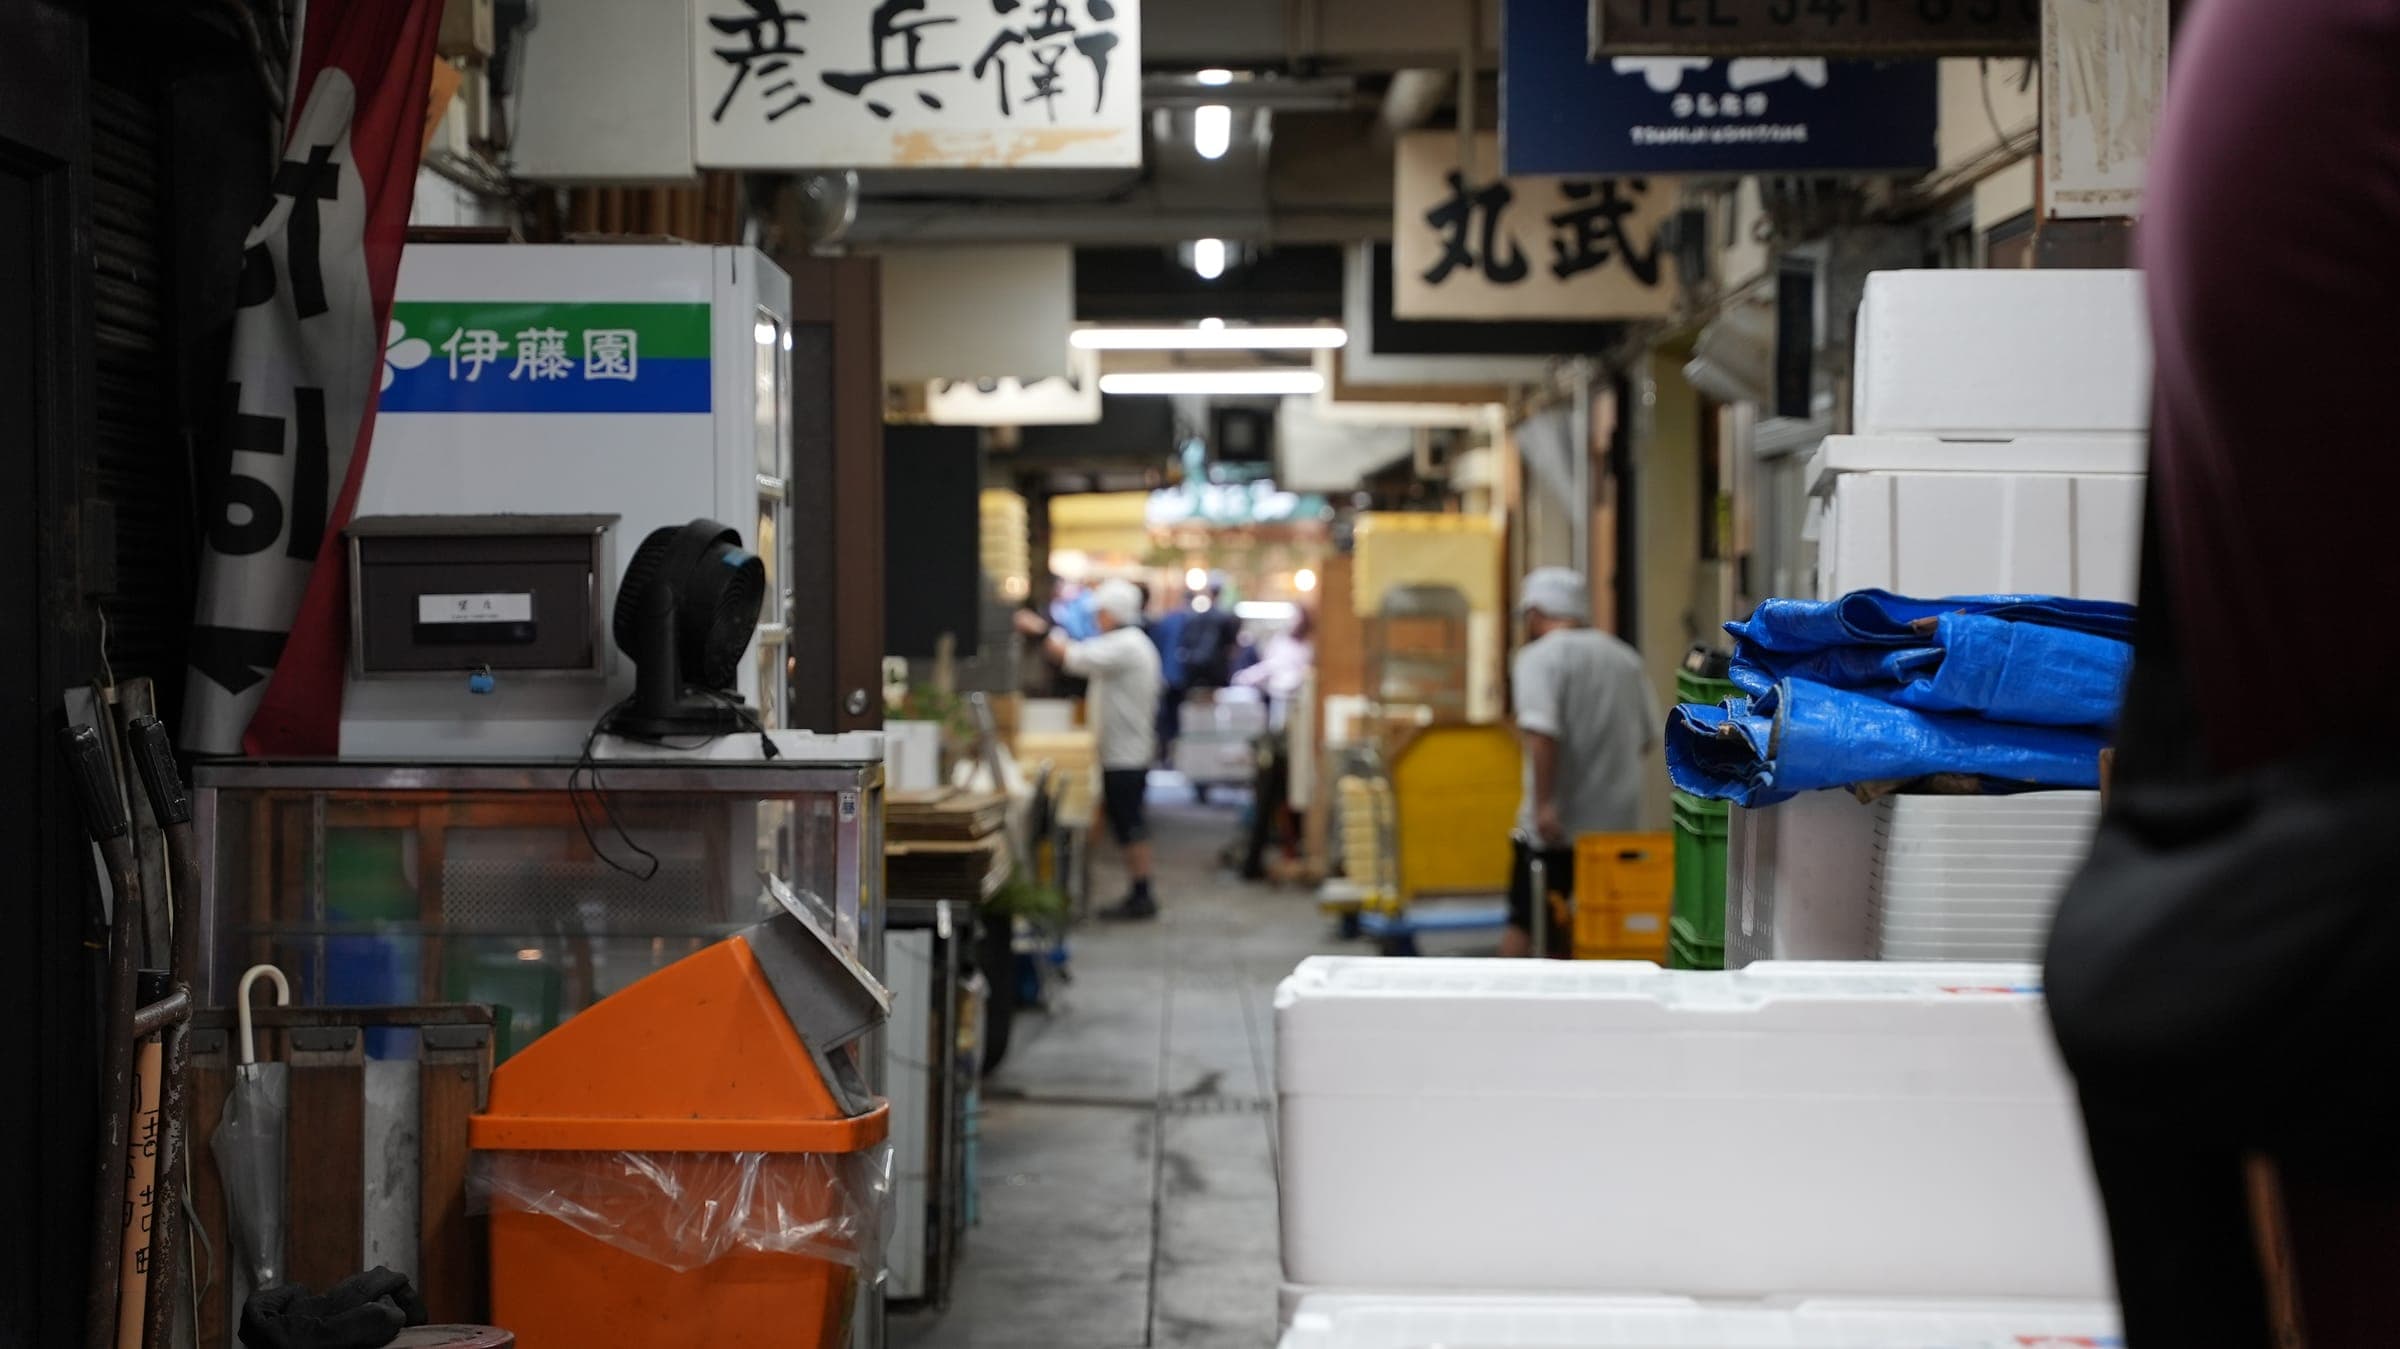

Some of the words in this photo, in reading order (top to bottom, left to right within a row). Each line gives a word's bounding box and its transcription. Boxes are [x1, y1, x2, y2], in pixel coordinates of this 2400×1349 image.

[708, 0, 1119, 122] 彦兵衛
[1422, 166, 1660, 286] 丸武
[441, 326, 638, 382] 伊藤園
